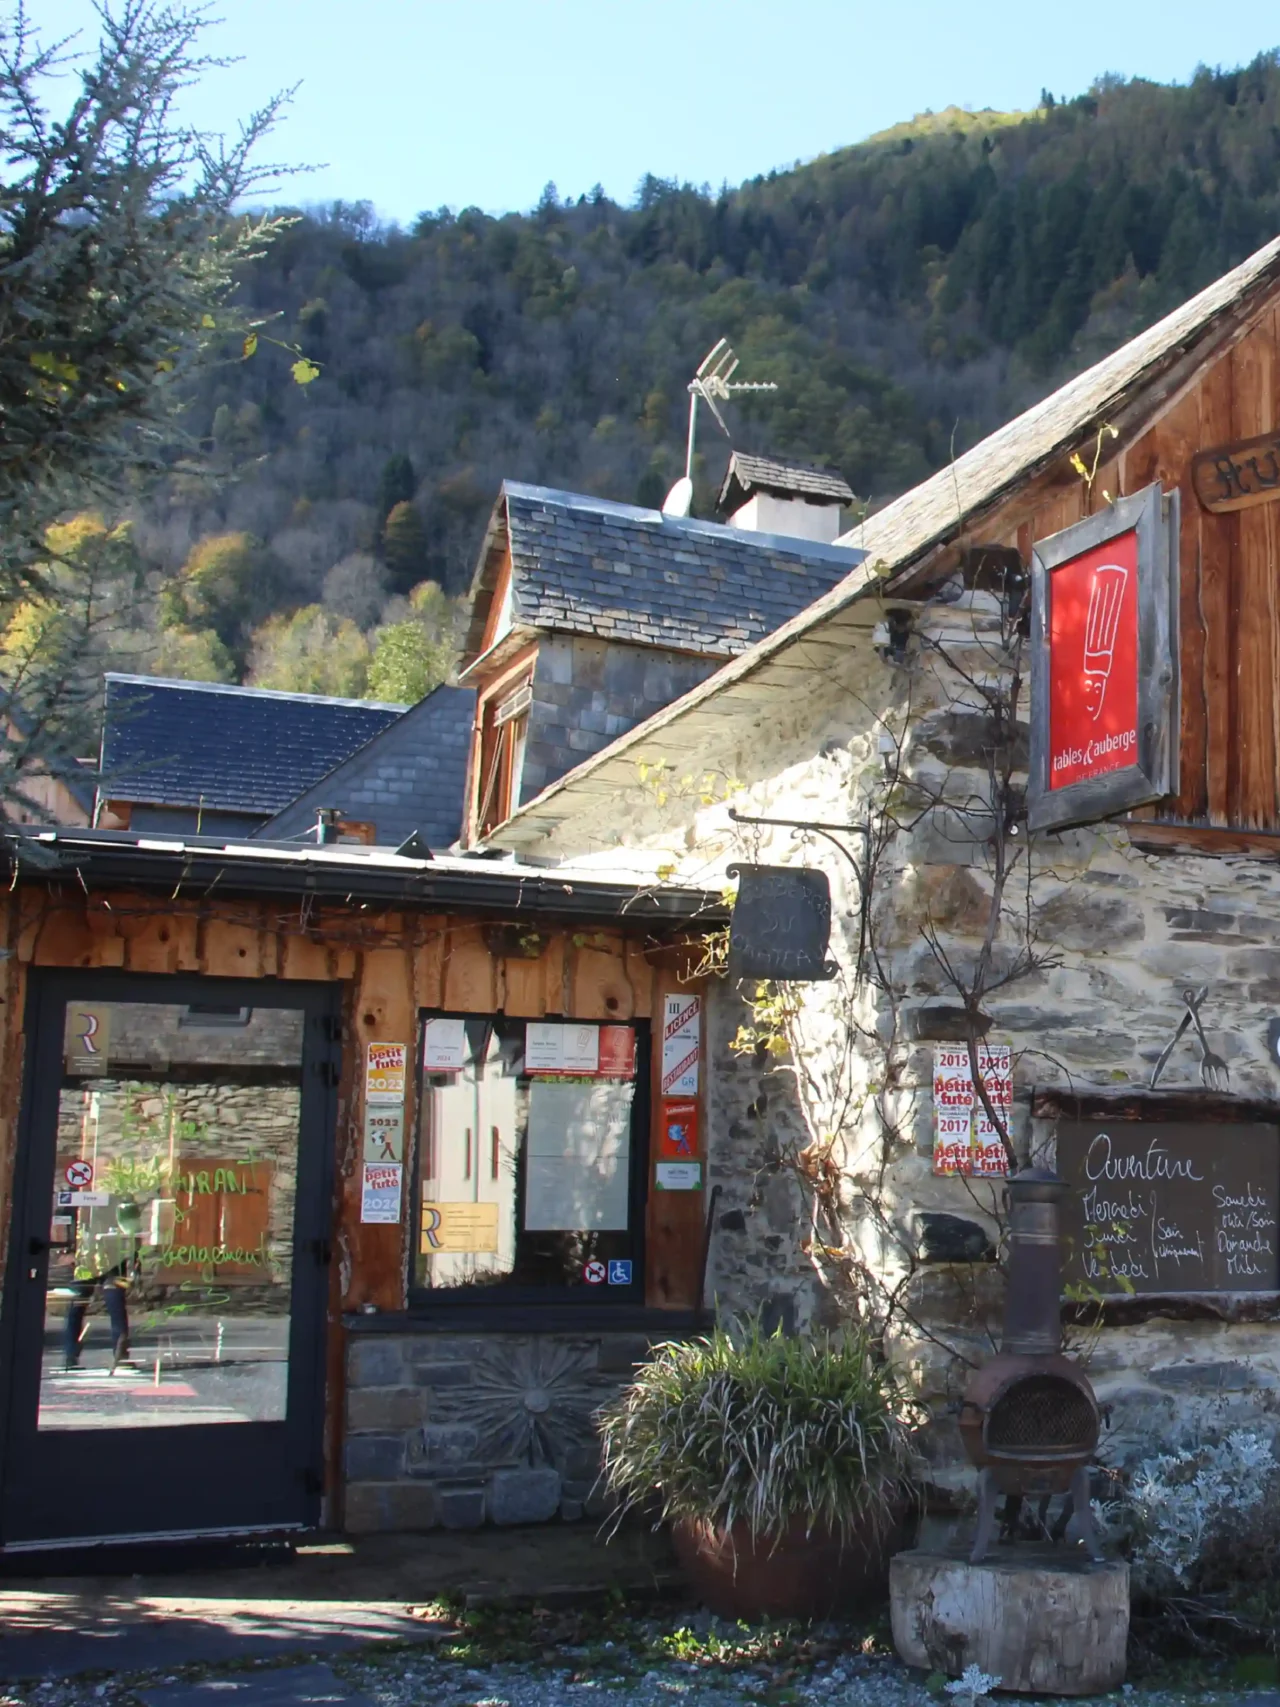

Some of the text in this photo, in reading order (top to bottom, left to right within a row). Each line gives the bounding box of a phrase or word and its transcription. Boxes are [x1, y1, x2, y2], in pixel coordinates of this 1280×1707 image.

[1053, 747, 1083, 772] tables
[665, 1000, 699, 1040] LICENCE
[368, 1048, 402, 1063] petit
[940, 1054, 969, 1067] 2015
[368, 1078, 404, 1090] 2023
[934, 1079, 974, 1095] petit
[979, 1080, 1013, 1093] etit
[986, 1093, 1012, 1105] uté
[369, 1118, 400, 1126] 2022
[940, 1120, 969, 1133] 2017
[979, 1120, 1008, 1133] 208
[934, 1146, 974, 1161] petit
[976, 1146, 1008, 1161] peti
[365, 1168, 398, 1183] petit
